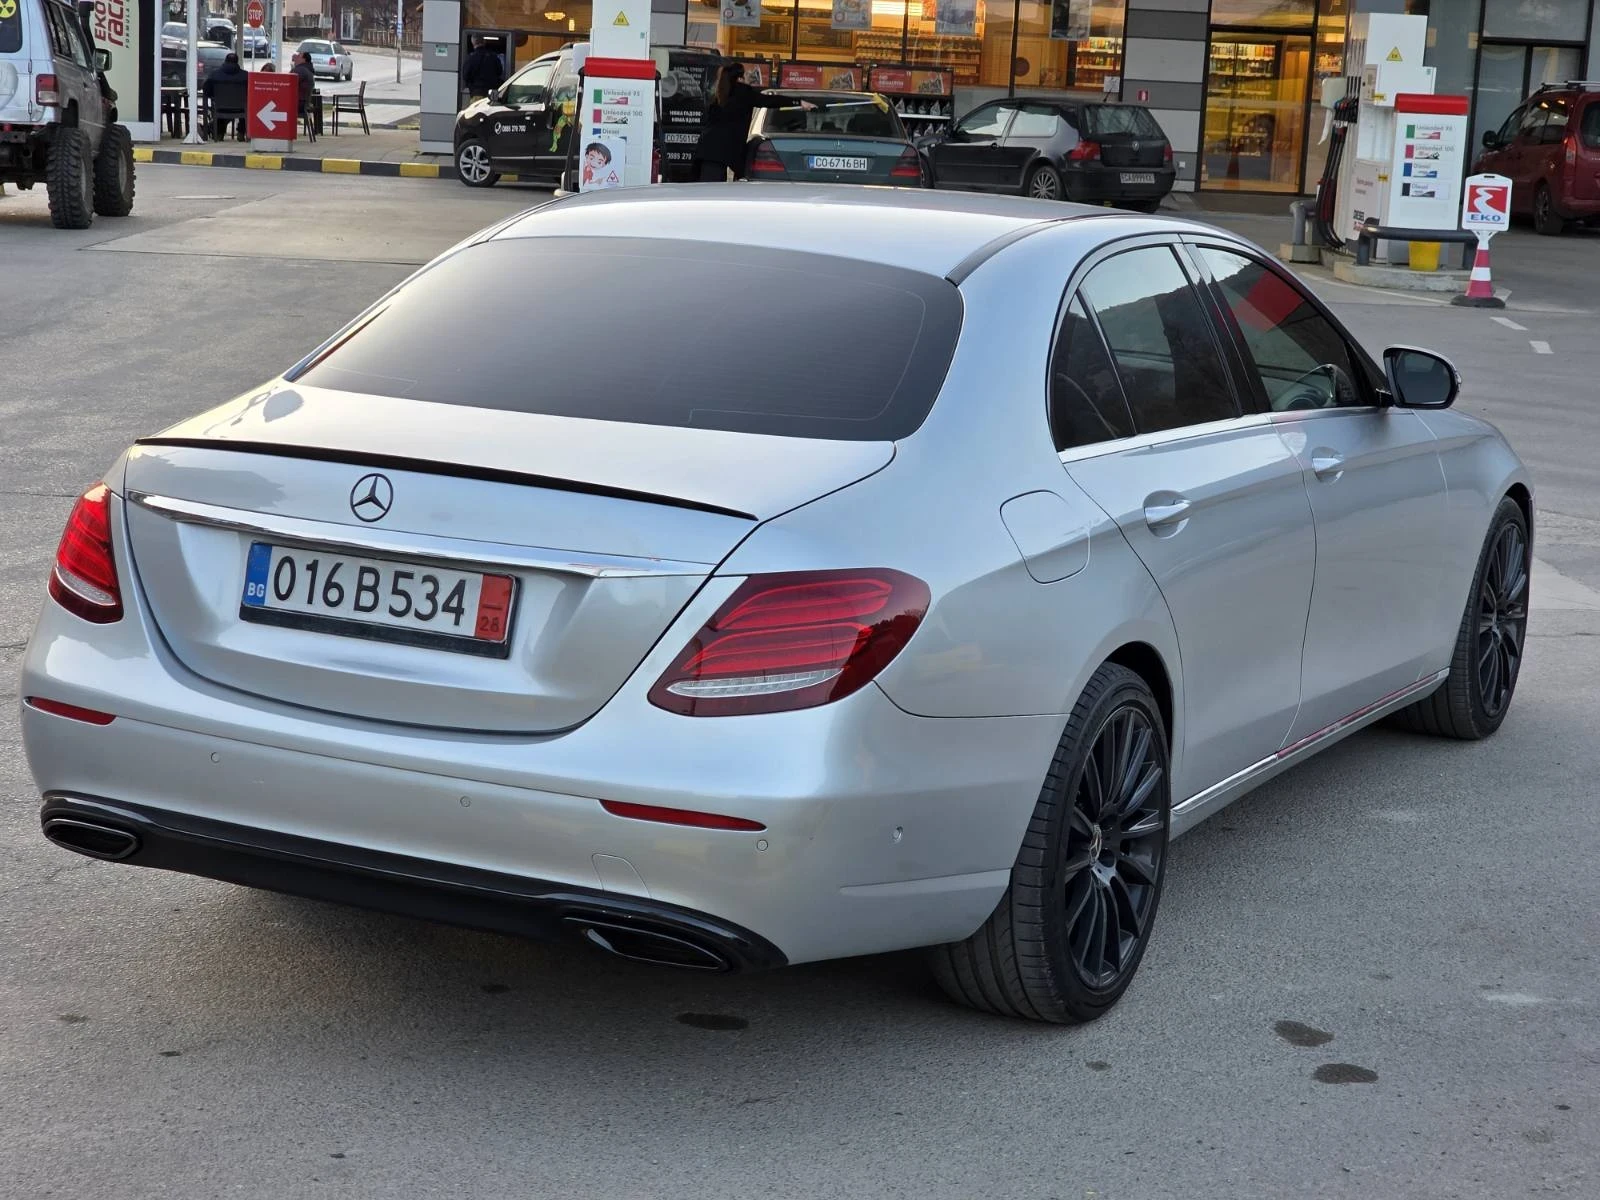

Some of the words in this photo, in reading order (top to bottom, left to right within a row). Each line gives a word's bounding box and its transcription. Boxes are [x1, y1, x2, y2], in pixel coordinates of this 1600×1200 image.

[94, 1, 106, 41] EKO
[248, 9, 262, 20] STOP
[1470, 214, 1501, 222] EKO
[247, 582, 265, 597] BG
[480, 616, 500, 632] 28
